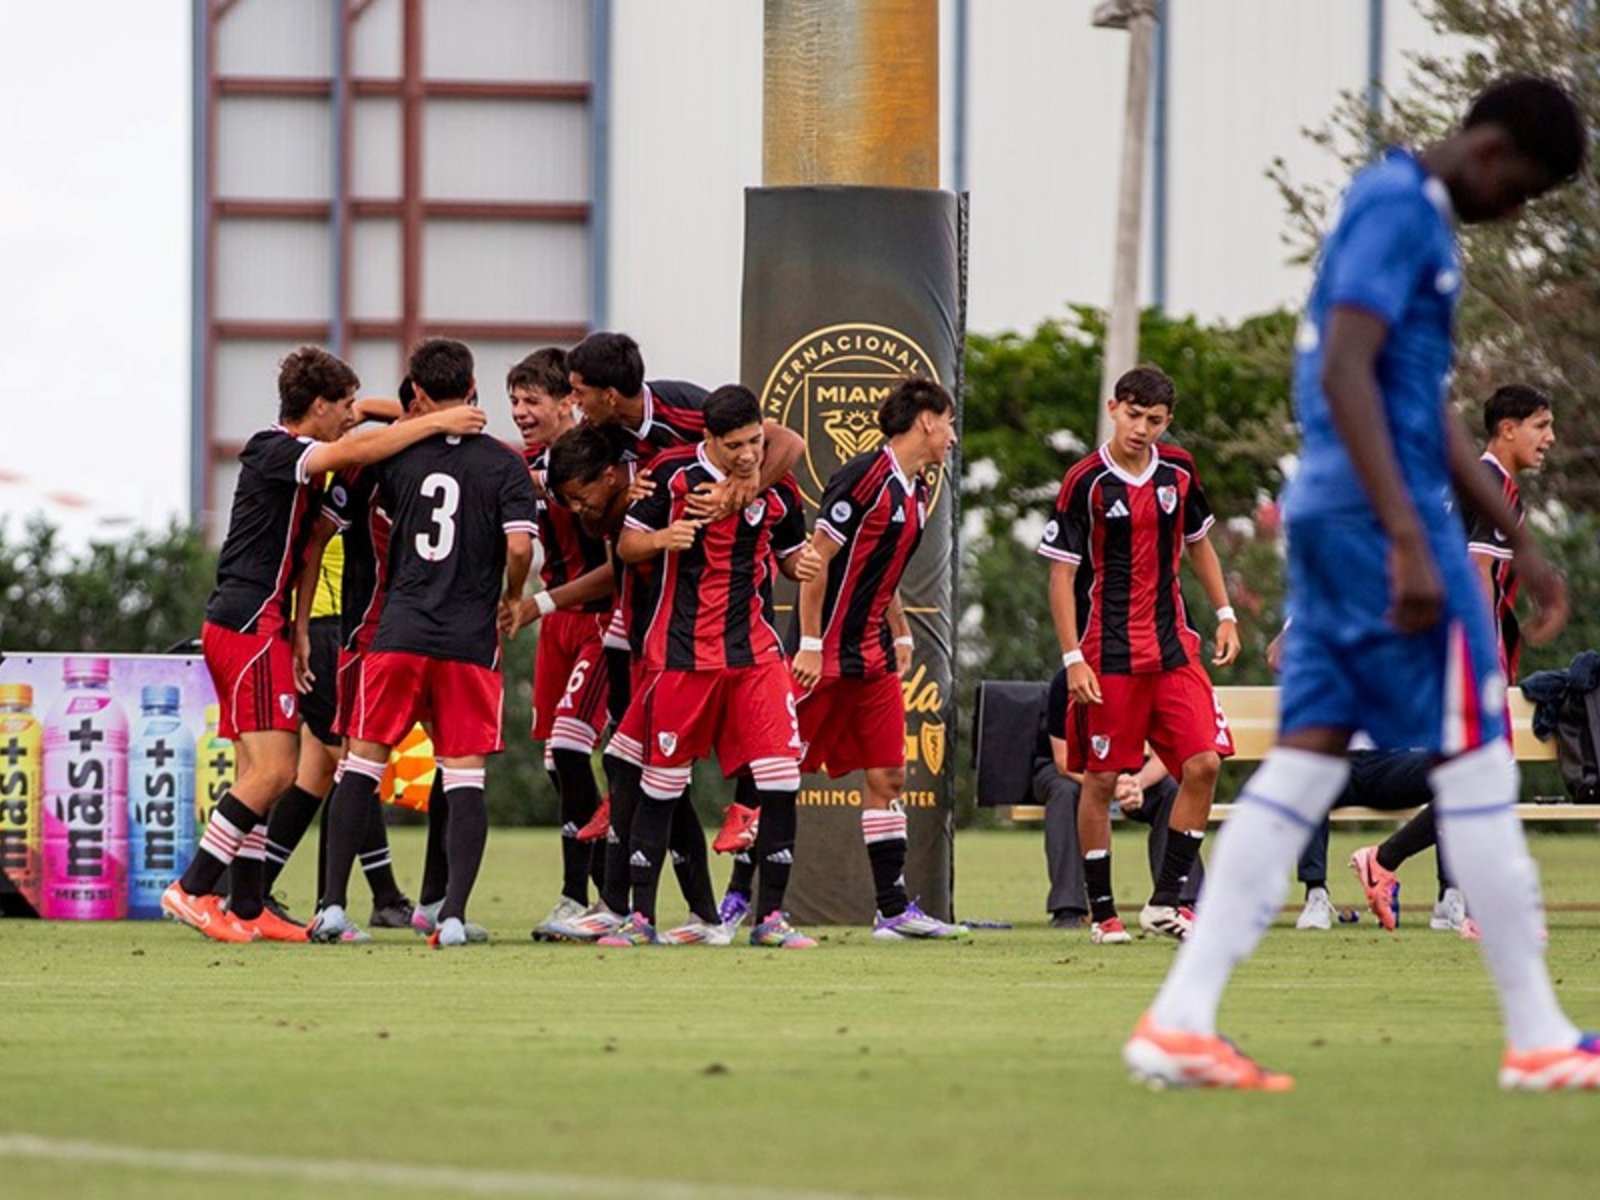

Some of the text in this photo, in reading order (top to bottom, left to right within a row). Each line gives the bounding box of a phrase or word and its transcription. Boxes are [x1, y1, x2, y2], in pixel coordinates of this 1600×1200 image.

[816, 386, 892, 403] MIAM
[415, 472, 460, 561] 3
[566, 659, 590, 693] 6
[56, 717, 104, 877] más+
[136, 738, 176, 870] más+
